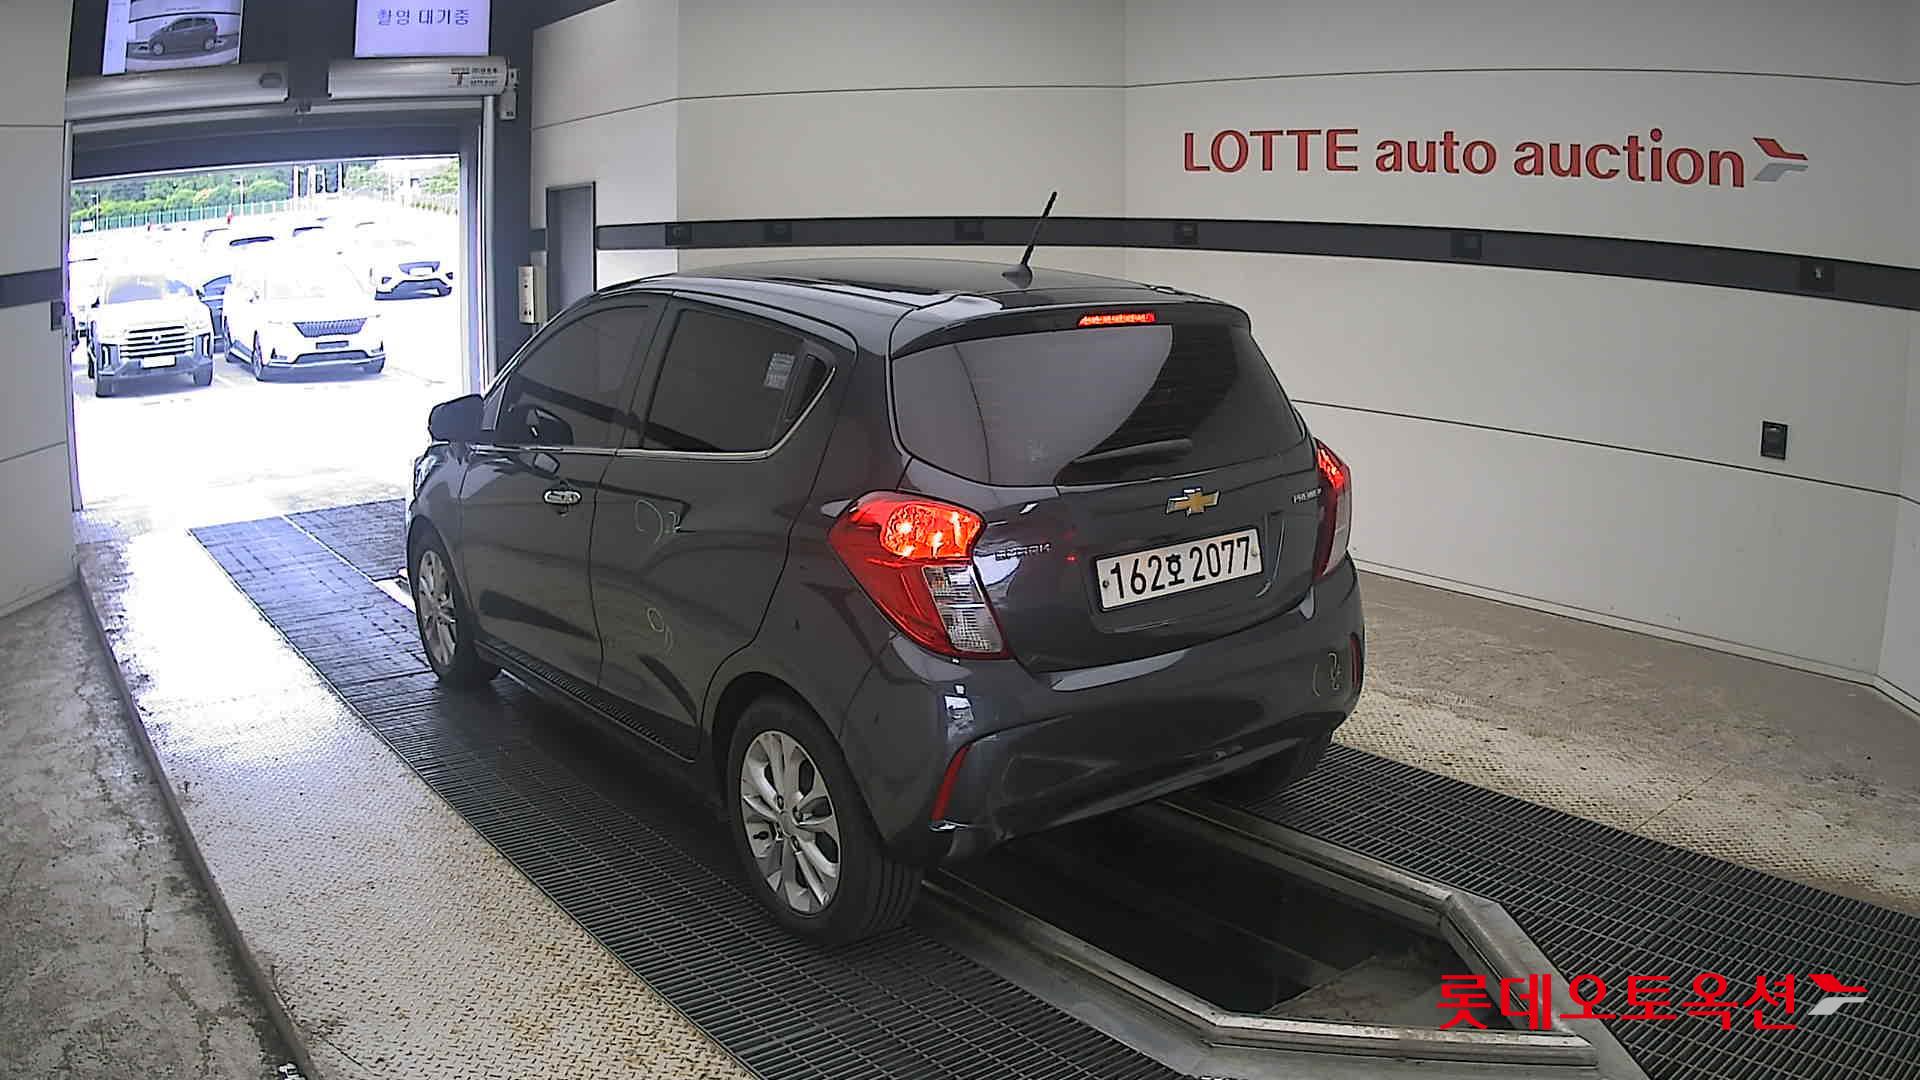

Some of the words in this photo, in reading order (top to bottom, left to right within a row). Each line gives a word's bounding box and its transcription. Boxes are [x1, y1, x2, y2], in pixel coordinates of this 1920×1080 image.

[418, 8, 470, 26] 대기중
[1184, 129, 1359, 172] LOTTE
[1375, 130, 1497, 175] auto
[1513, 127, 1745, 188] auction
[1110, 554, 1185, 599] 162호
[1189, 535, 1250, 582] 2077
